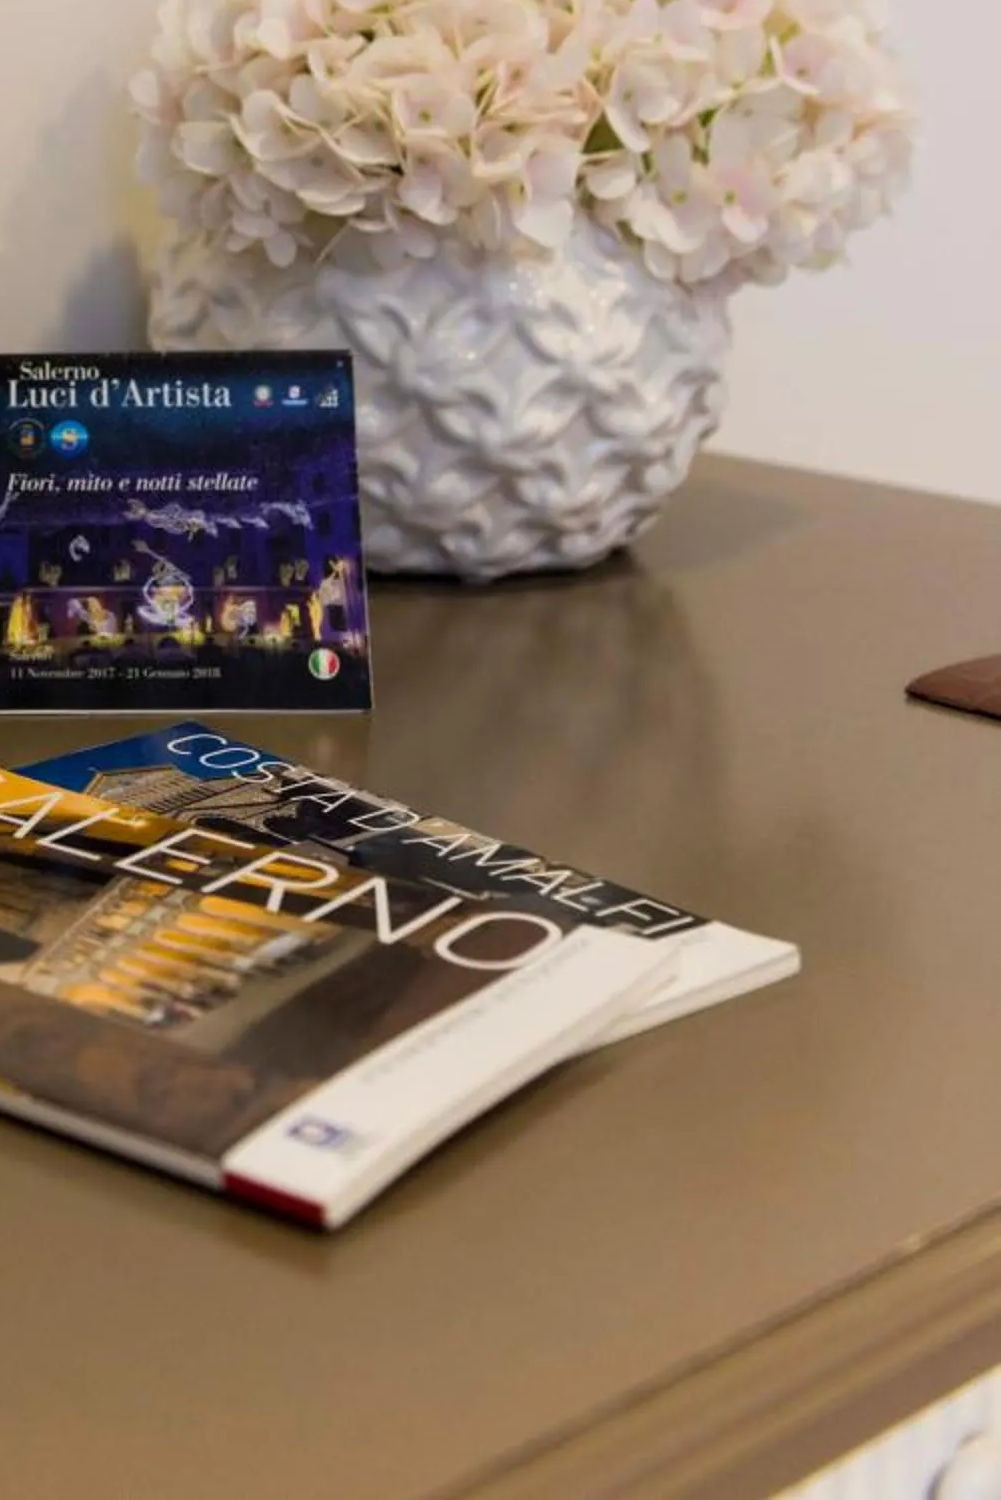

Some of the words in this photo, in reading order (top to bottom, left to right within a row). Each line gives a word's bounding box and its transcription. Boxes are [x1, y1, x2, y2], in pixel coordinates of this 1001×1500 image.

[19, 361, 100, 381] Salerno
[7, 379, 79, 409] Luci
[7, 473, 61, 493] Fiori,
[67, 471, 113, 493] mito
[118, 477, 132, 493] e
[135, 472, 183, 493] notti
[186, 472, 259, 493] stellate
[166, 733, 357, 813] COSTA
